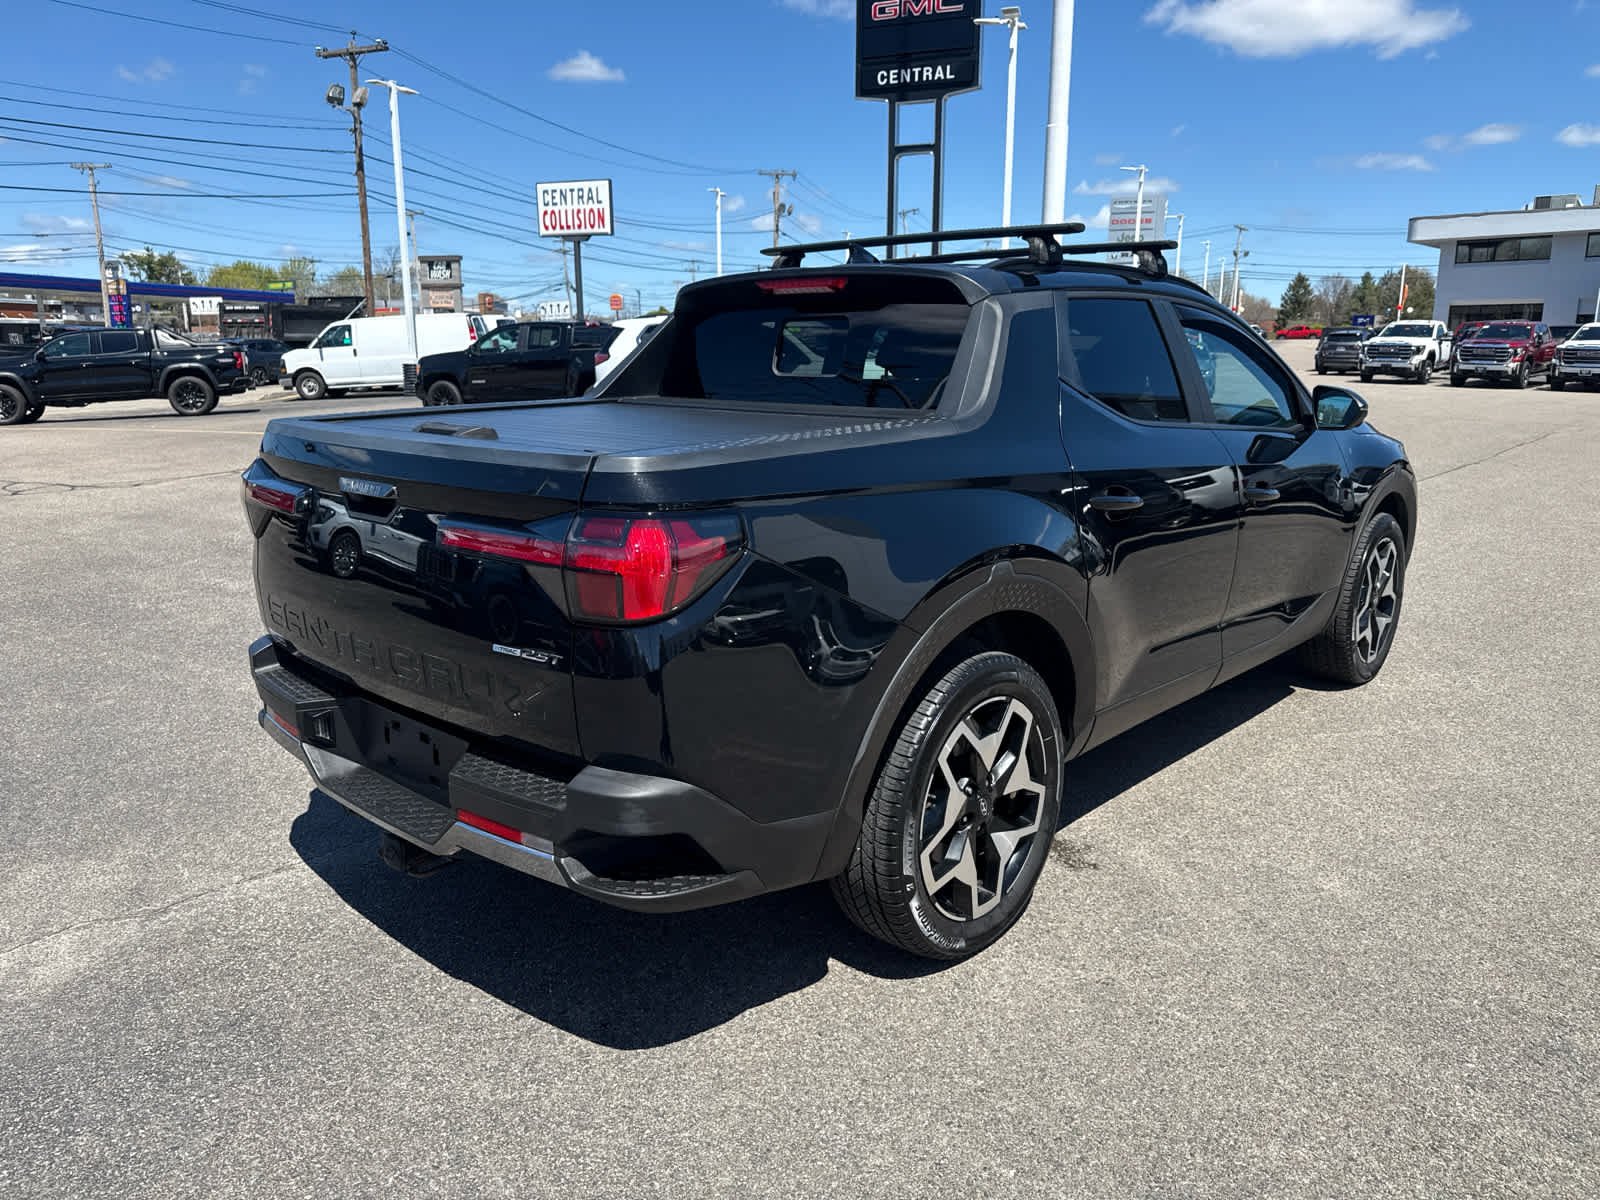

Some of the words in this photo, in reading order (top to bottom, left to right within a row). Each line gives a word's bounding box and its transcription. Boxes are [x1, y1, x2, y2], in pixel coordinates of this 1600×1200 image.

[871, 0, 964, 21] GMC
[877, 64, 955, 86] CENTRAL
[542, 185, 603, 207] CENTRAL
[542, 207, 606, 231] COLLISION
[430, 269, 451, 280] WASH
